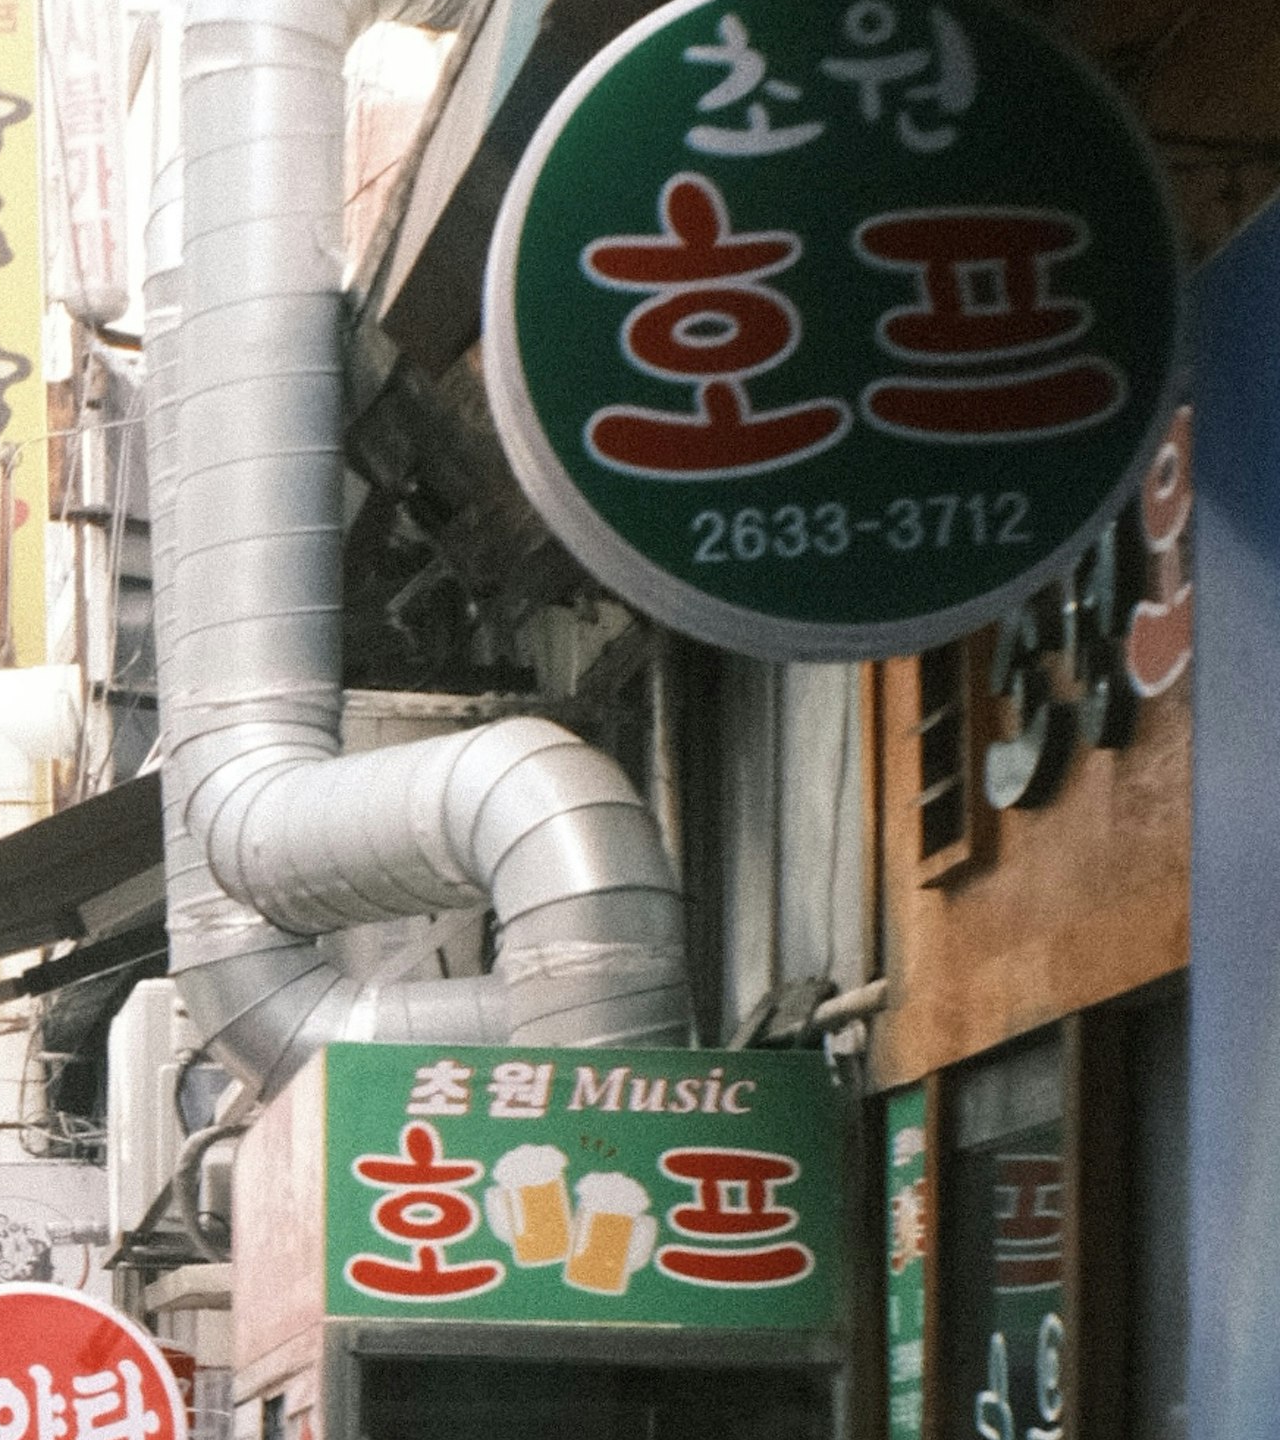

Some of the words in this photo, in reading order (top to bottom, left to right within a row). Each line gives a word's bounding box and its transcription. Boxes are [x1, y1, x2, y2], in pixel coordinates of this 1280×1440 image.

[682, 0, 979, 156] 초원
[581, 171, 1129, 481] 호프
[691, 490, 1032, 564] 2633-3712
[407, 1060, 554, 1119] 초원
[567, 1067, 758, 1115] Music
